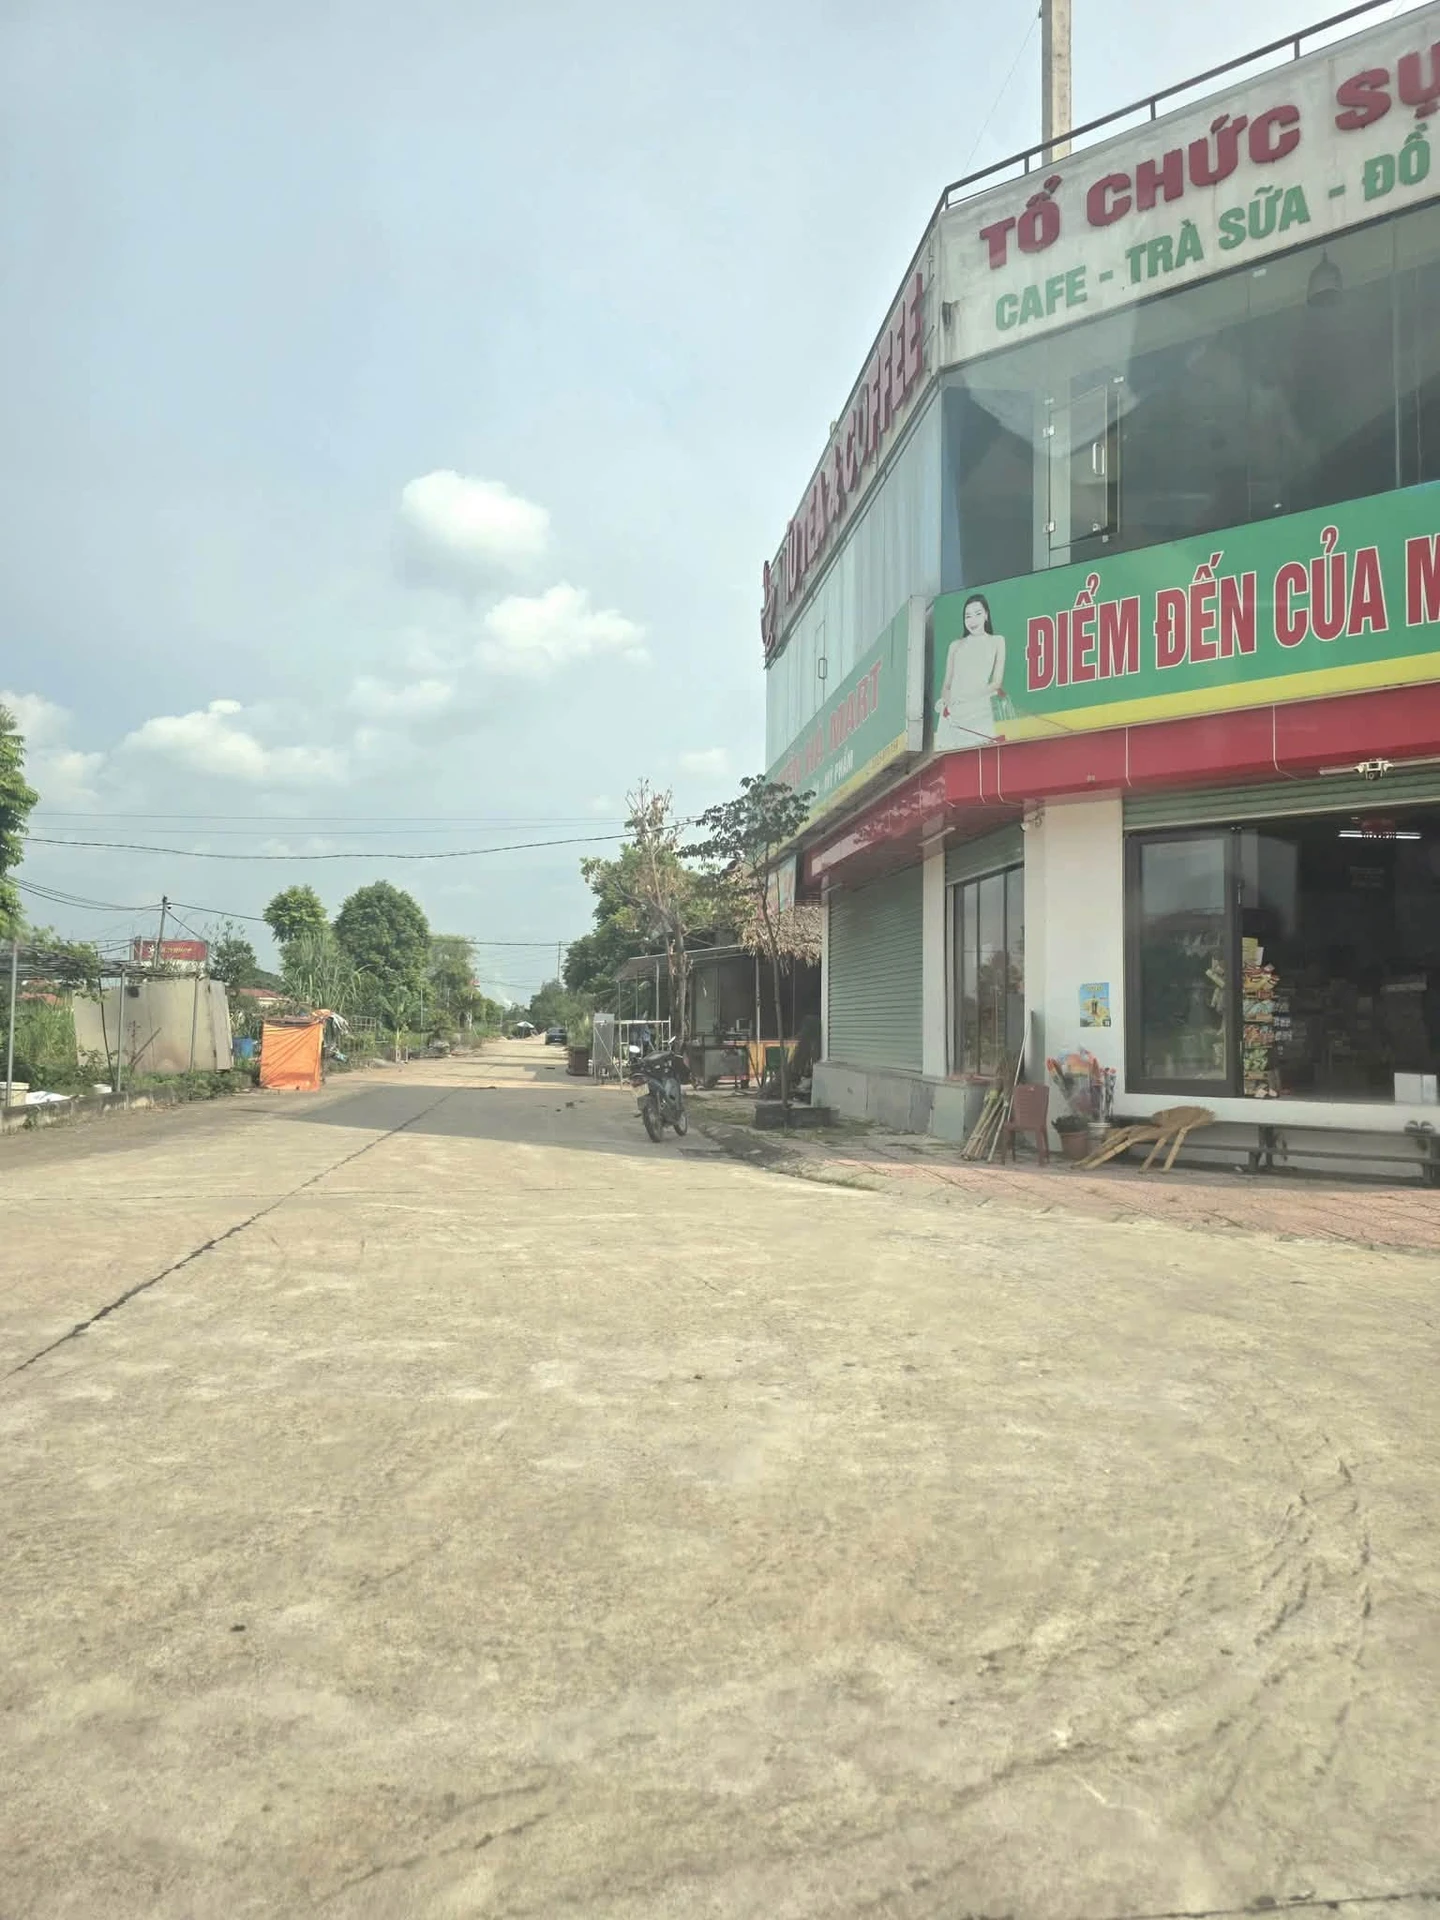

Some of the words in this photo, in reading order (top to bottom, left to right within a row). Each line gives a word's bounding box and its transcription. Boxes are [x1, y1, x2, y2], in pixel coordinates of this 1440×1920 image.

[980, 174, 1062, 270] TỔ
[1086, 104, 1300, 227] CHỨC
[996, 265, 1088, 331] CAFE
[1125, 218, 1204, 284] TRÀ
[1218, 185, 1310, 250] SỮA
[1361, 122, 1431, 202] ĐỒ
[842, 272, 923, 494] COFFEE
[1026, 572, 1140, 692] ĐIỂM
[1154, 550, 1258, 670] ĐẾN
[1274, 524, 1390, 649] CỦA
[829, 656, 883, 756] MART
